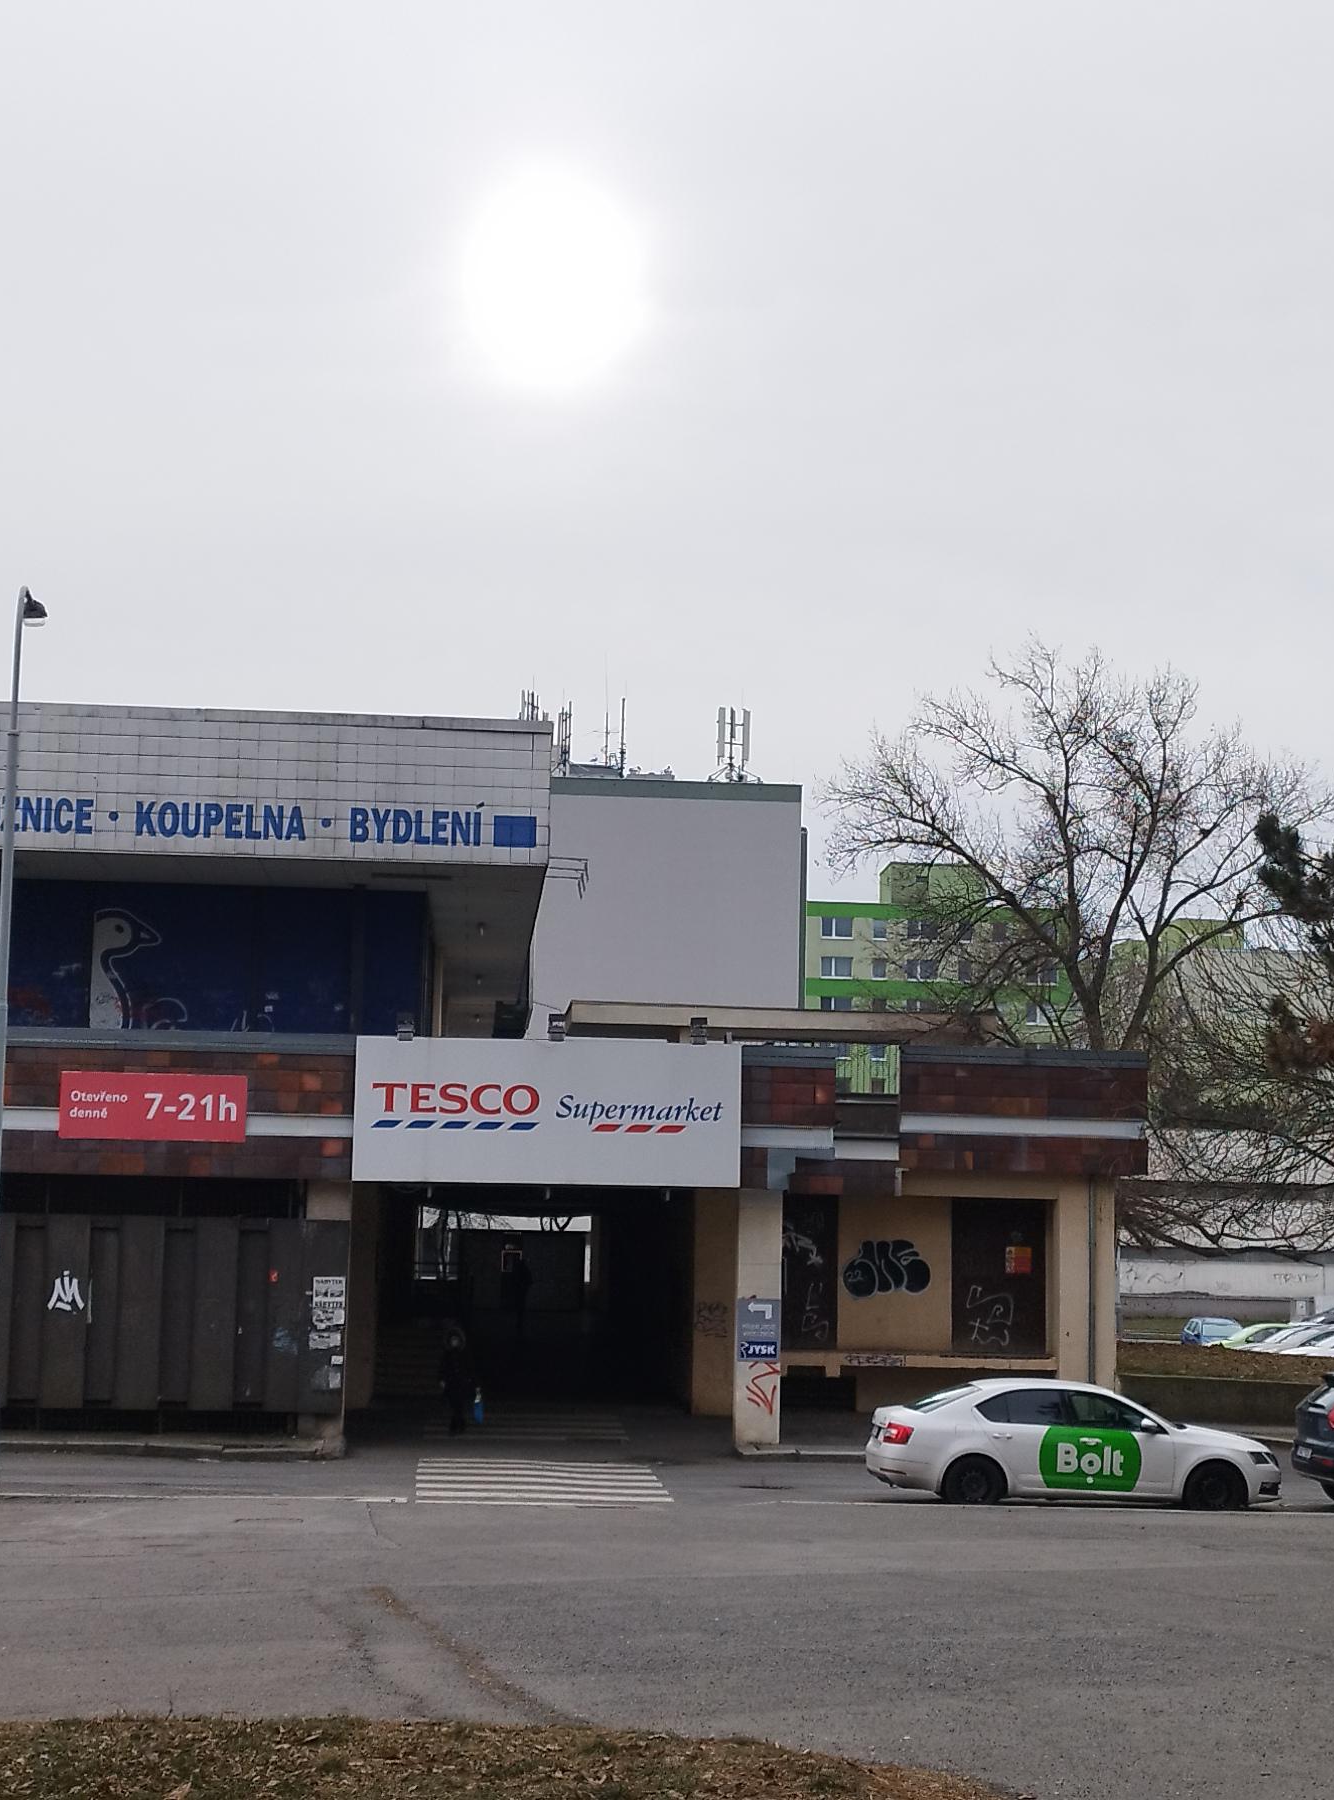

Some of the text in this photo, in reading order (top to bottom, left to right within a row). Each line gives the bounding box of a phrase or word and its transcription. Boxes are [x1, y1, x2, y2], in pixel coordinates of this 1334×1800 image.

[135, 801, 306, 841] KOUPELNA
[350, 802, 484, 847] BYDLENÍ
[70, 1090, 128, 1103] Otevřeno
[144, 1093, 237, 1121] 7-21h
[372, 1083, 723, 1125] TESCO Supermarket
[748, 1345, 776, 1355] JYSK
[1056, 1443, 1124, 1477] Bolt
